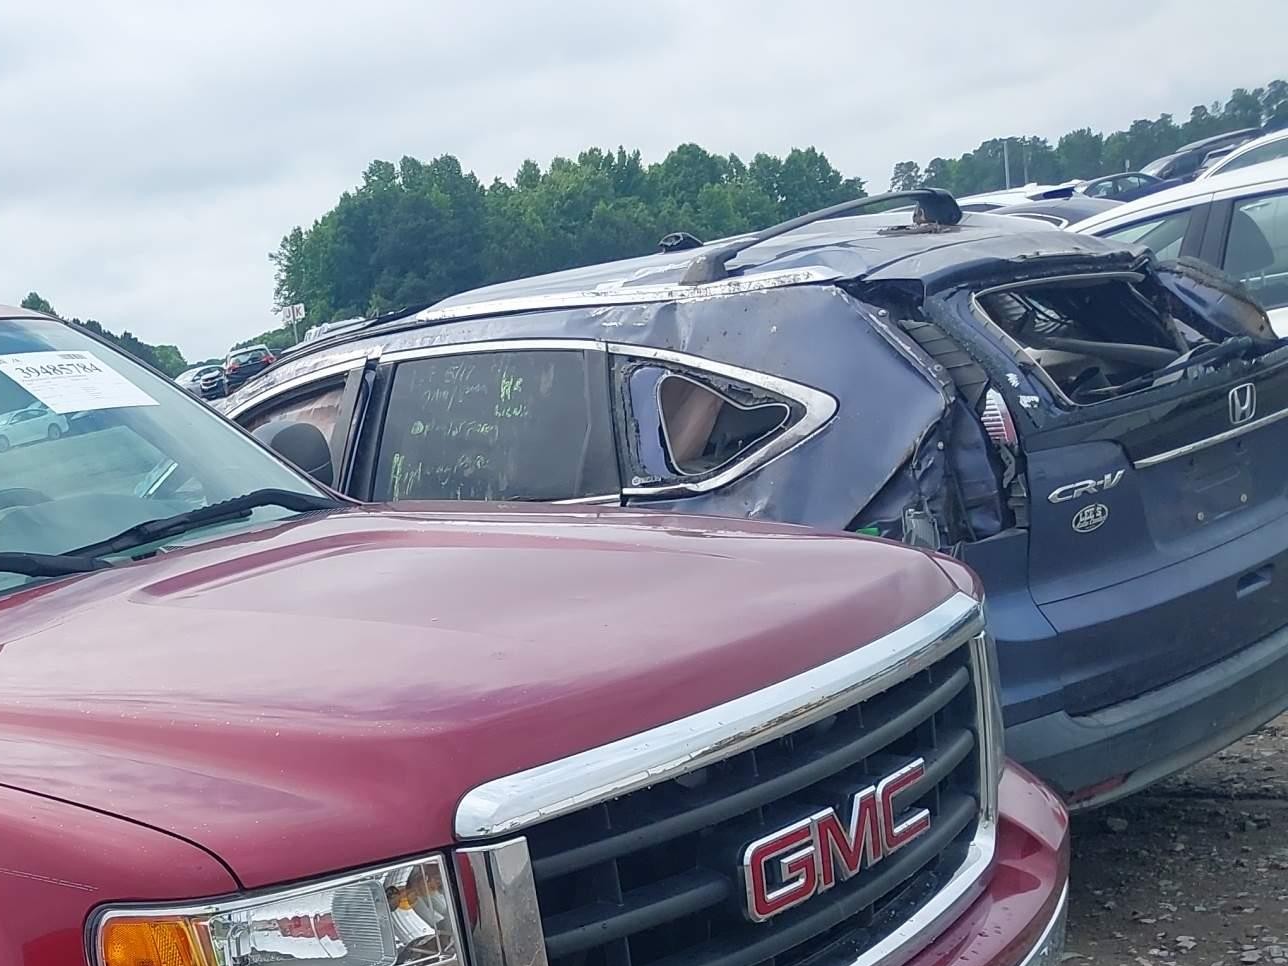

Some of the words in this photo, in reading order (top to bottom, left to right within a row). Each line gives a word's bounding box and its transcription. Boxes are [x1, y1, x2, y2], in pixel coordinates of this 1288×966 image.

[15, 362, 103, 379] 39485784
[1047, 468, 1126, 504] CR-V
[743, 756, 931, 923] GMC
